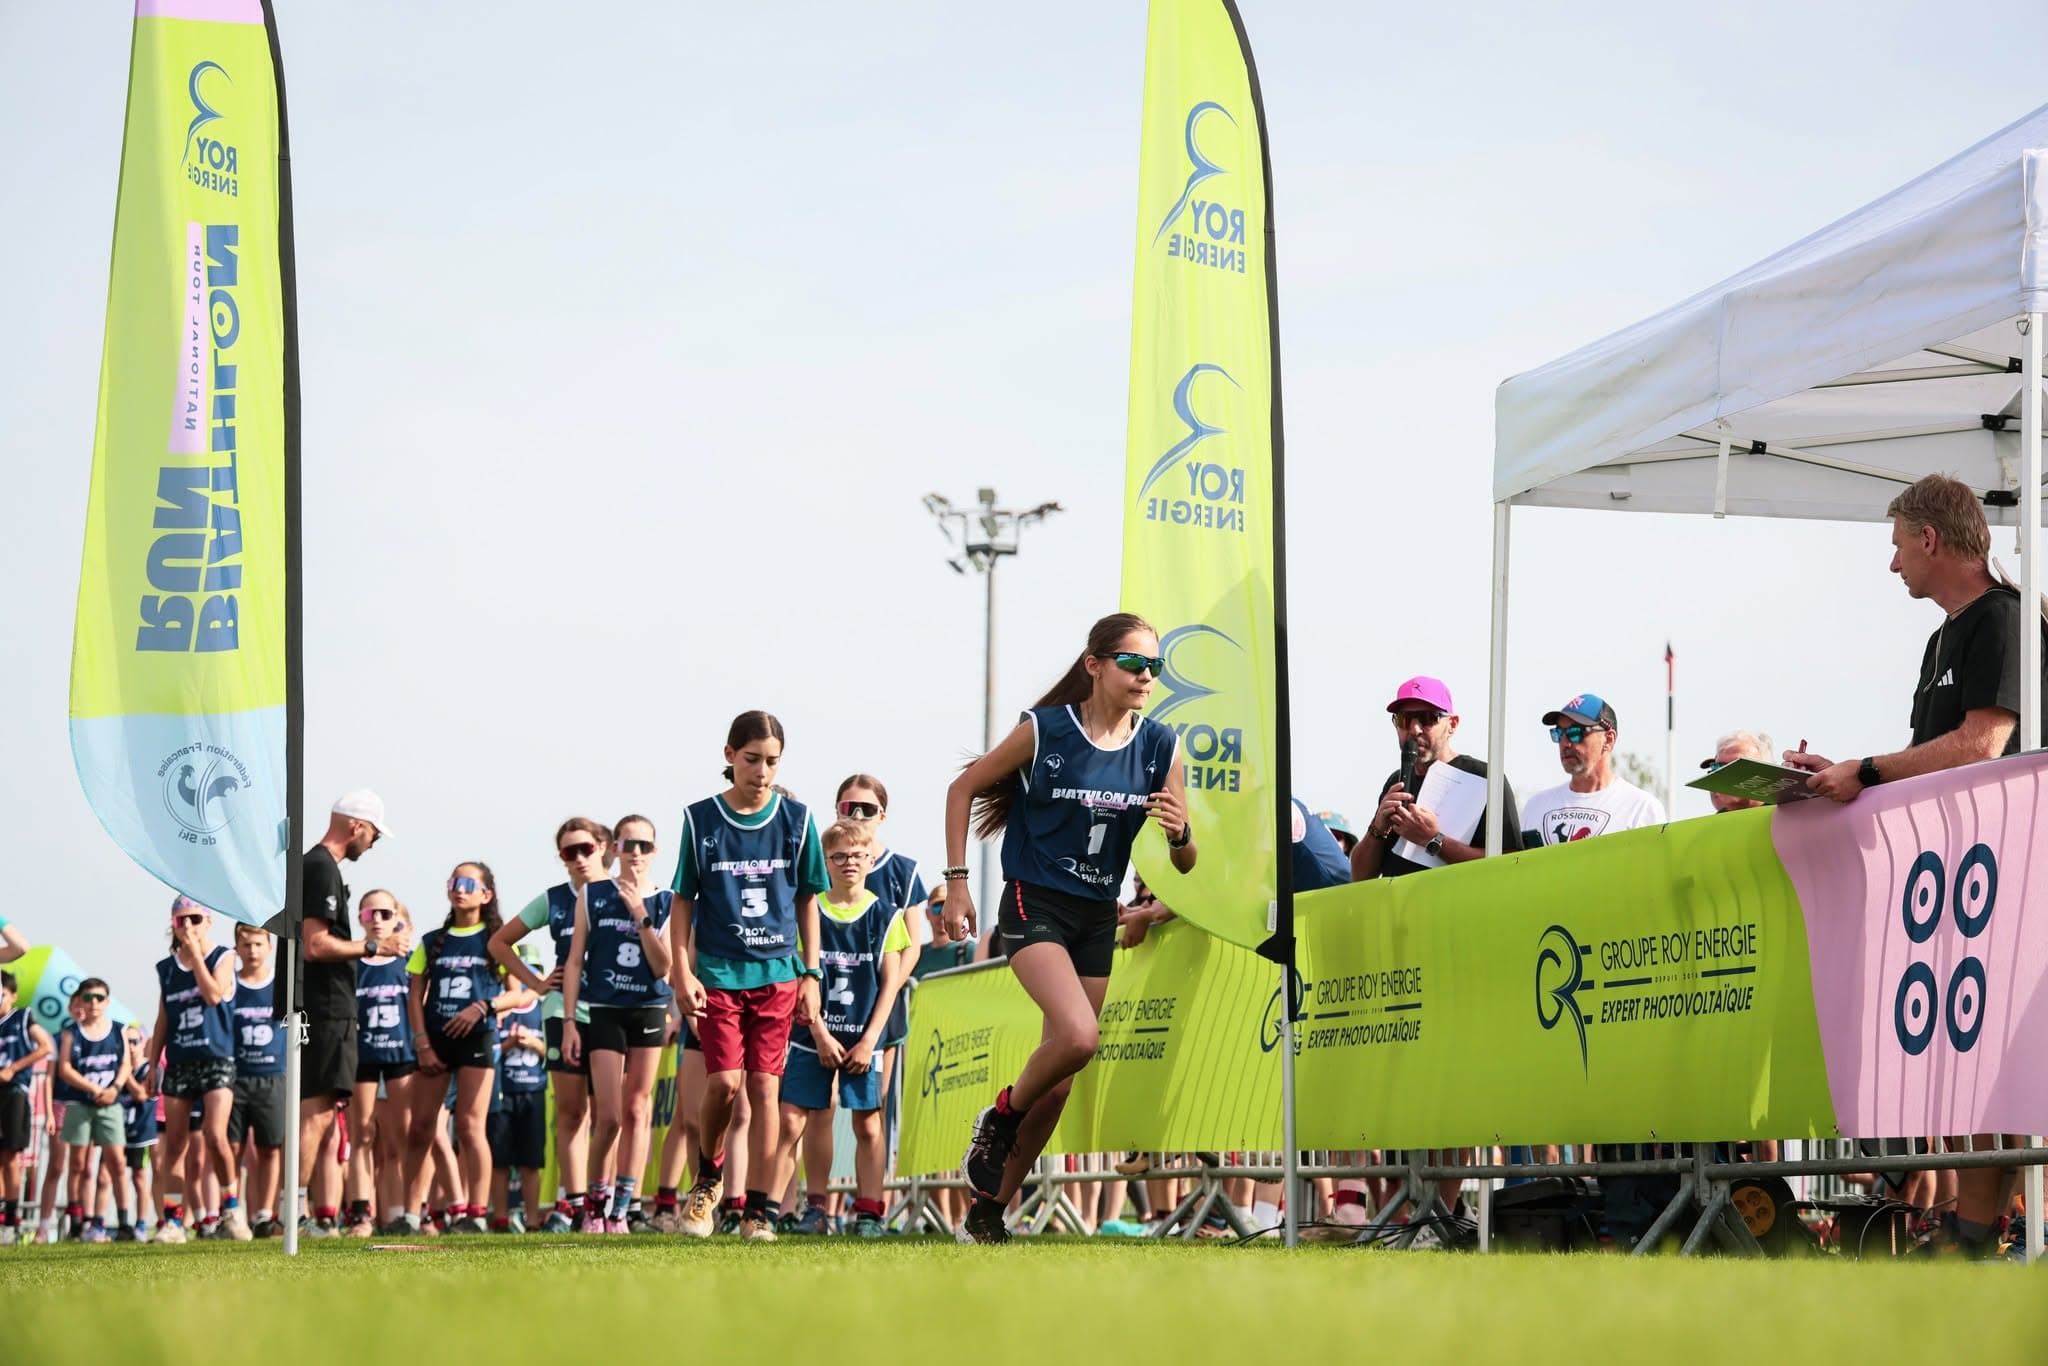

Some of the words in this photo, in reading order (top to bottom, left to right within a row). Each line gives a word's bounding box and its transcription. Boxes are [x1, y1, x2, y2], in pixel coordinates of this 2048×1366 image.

[1052, 788, 1125, 804] BIATHLON
[1551, 812, 1600, 823] ROSSIGNOL
[1087, 823, 1107, 855] 1
[741, 887, 769, 917] 3
[745, 927, 766, 937] ROY
[746, 934, 784, 945] ENERGIE
[616, 942, 640, 968] 8
[1600, 936, 1658, 971] GROUPE
[1661, 931, 1691, 964] ROY
[1695, 924, 1757, 960] ENERGIE
[439, 976, 473, 999] 12
[616, 974, 634, 983] ROY
[1316, 976, 1356, 1006] GROUPE
[1358, 973, 1379, 1000] ROY
[1381, 967, 1422, 997] ENERGIE
[1112, 1000, 1137, 1022] ROY
[1135, 997, 1177, 1021] ENERGIE
[1601, 997, 1641, 1024] EXPERT
[1642, 983, 1755, 1020] PHOTOVOLTAÏQUE
[178, 1005, 204, 1031] 15
[828, 1014, 847, 1023] ROY
[241, 1024, 274, 1046] 19
[1308, 1027, 1340, 1049] EXPERT
[1339, 1017, 1421, 1047] PHOTOVOLTAÏQUE
[1095, 1038, 1166, 1061] HOTOVOLTAÏQUE
